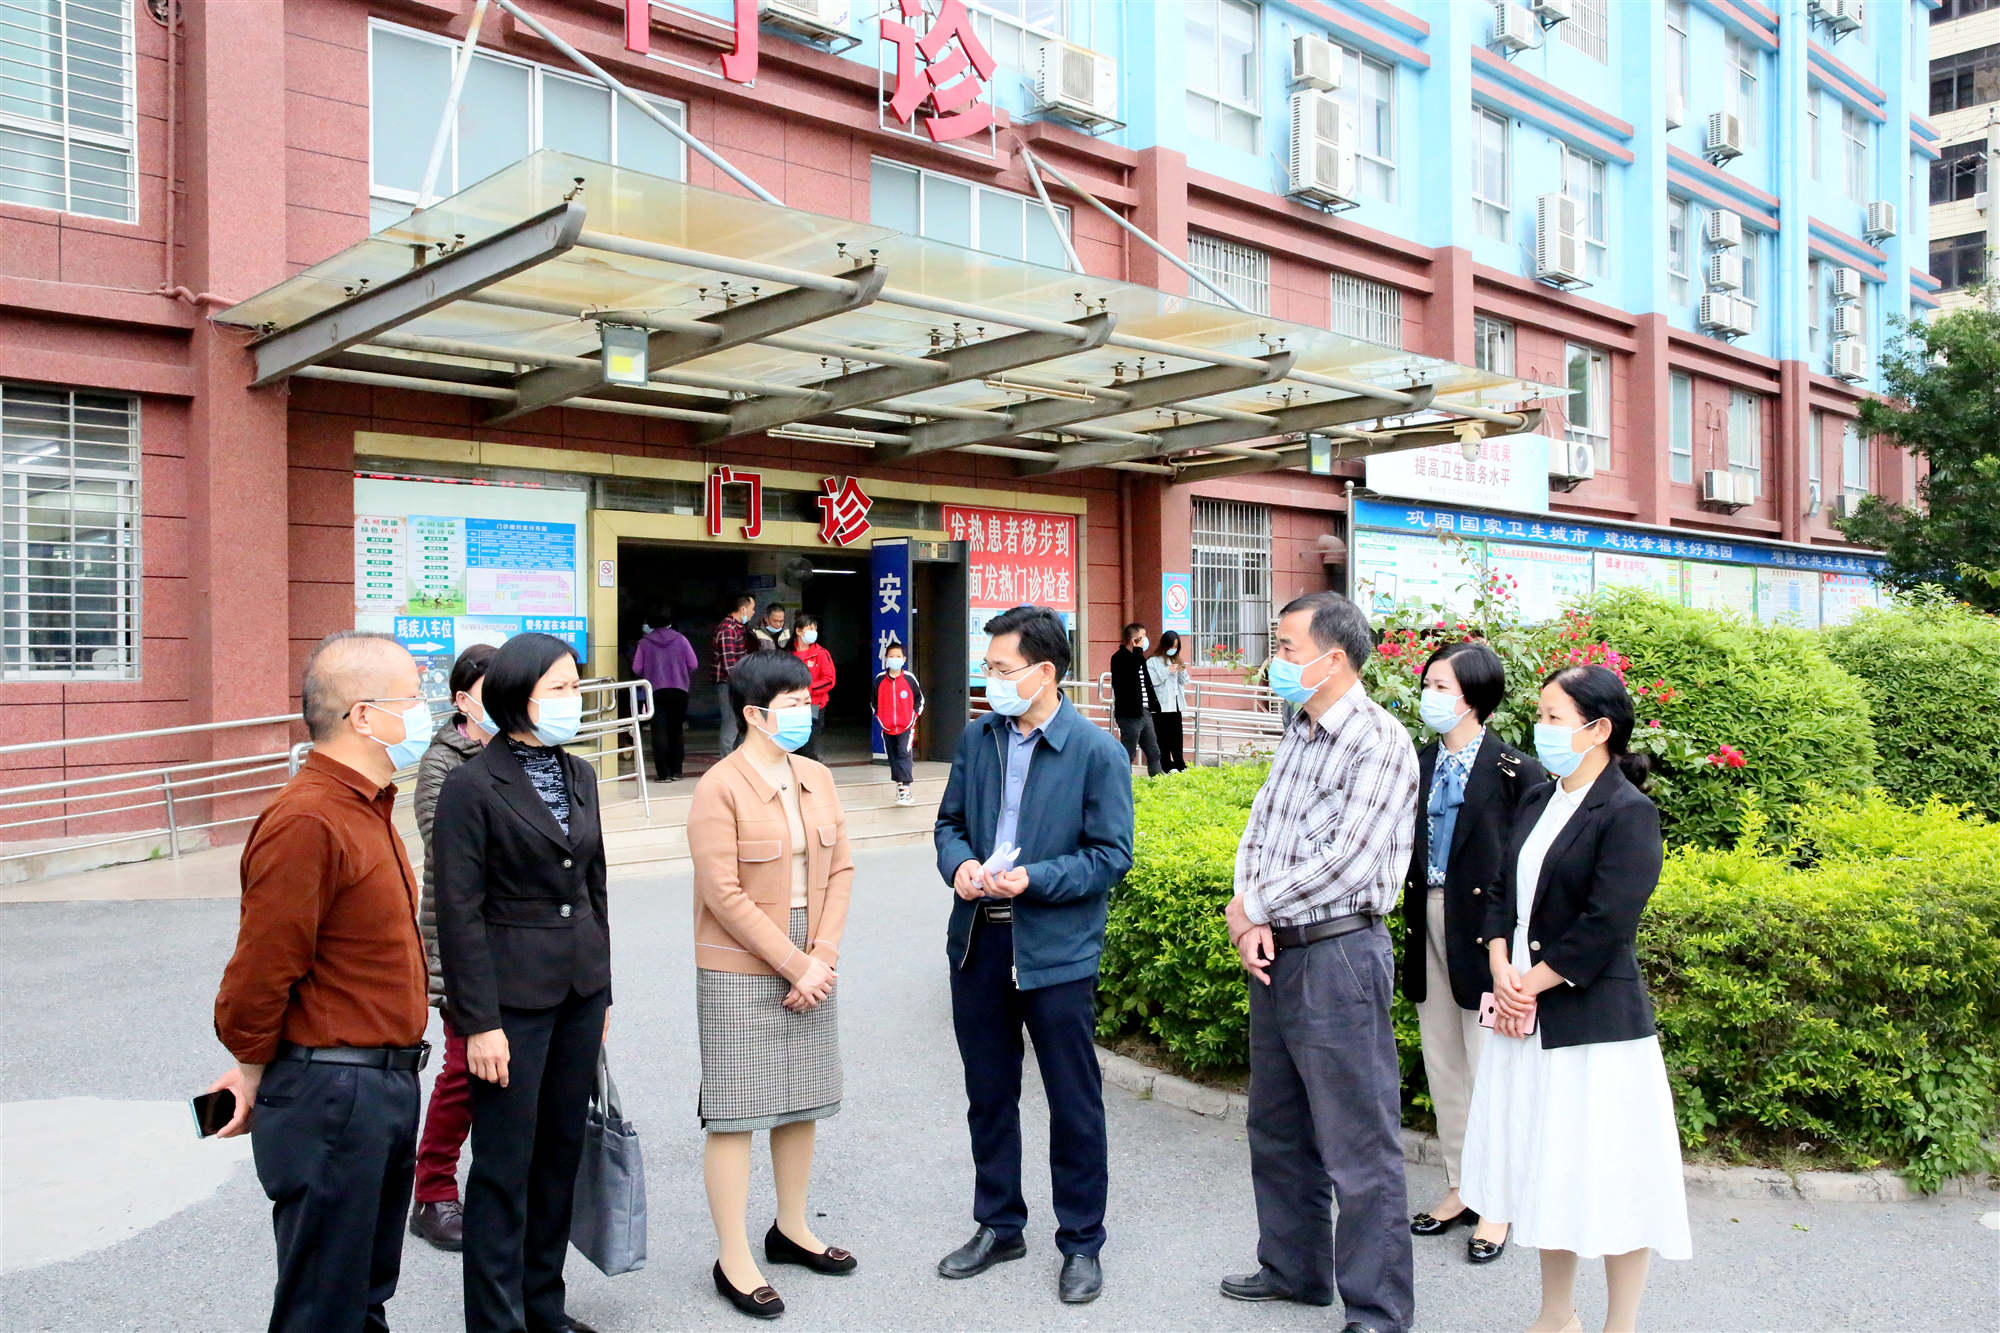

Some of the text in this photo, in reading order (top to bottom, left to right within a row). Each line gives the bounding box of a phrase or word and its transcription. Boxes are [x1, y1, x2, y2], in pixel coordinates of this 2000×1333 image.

[1415, 457, 1511, 488] 提高卫生服务水平
[707, 464, 873, 547] 门诊
[951, 511, 1070, 557] 发热患者移步到
[1406, 510, 1589, 544] 巩固国家卫生城市
[1602, 531, 1733, 559] 建设幸福美好家园
[969, 562, 1070, 603] 面发热门诊检查
[396, 618, 453, 640] 残疾人车位
[524, 618, 584, 632] 警务室在本医院
